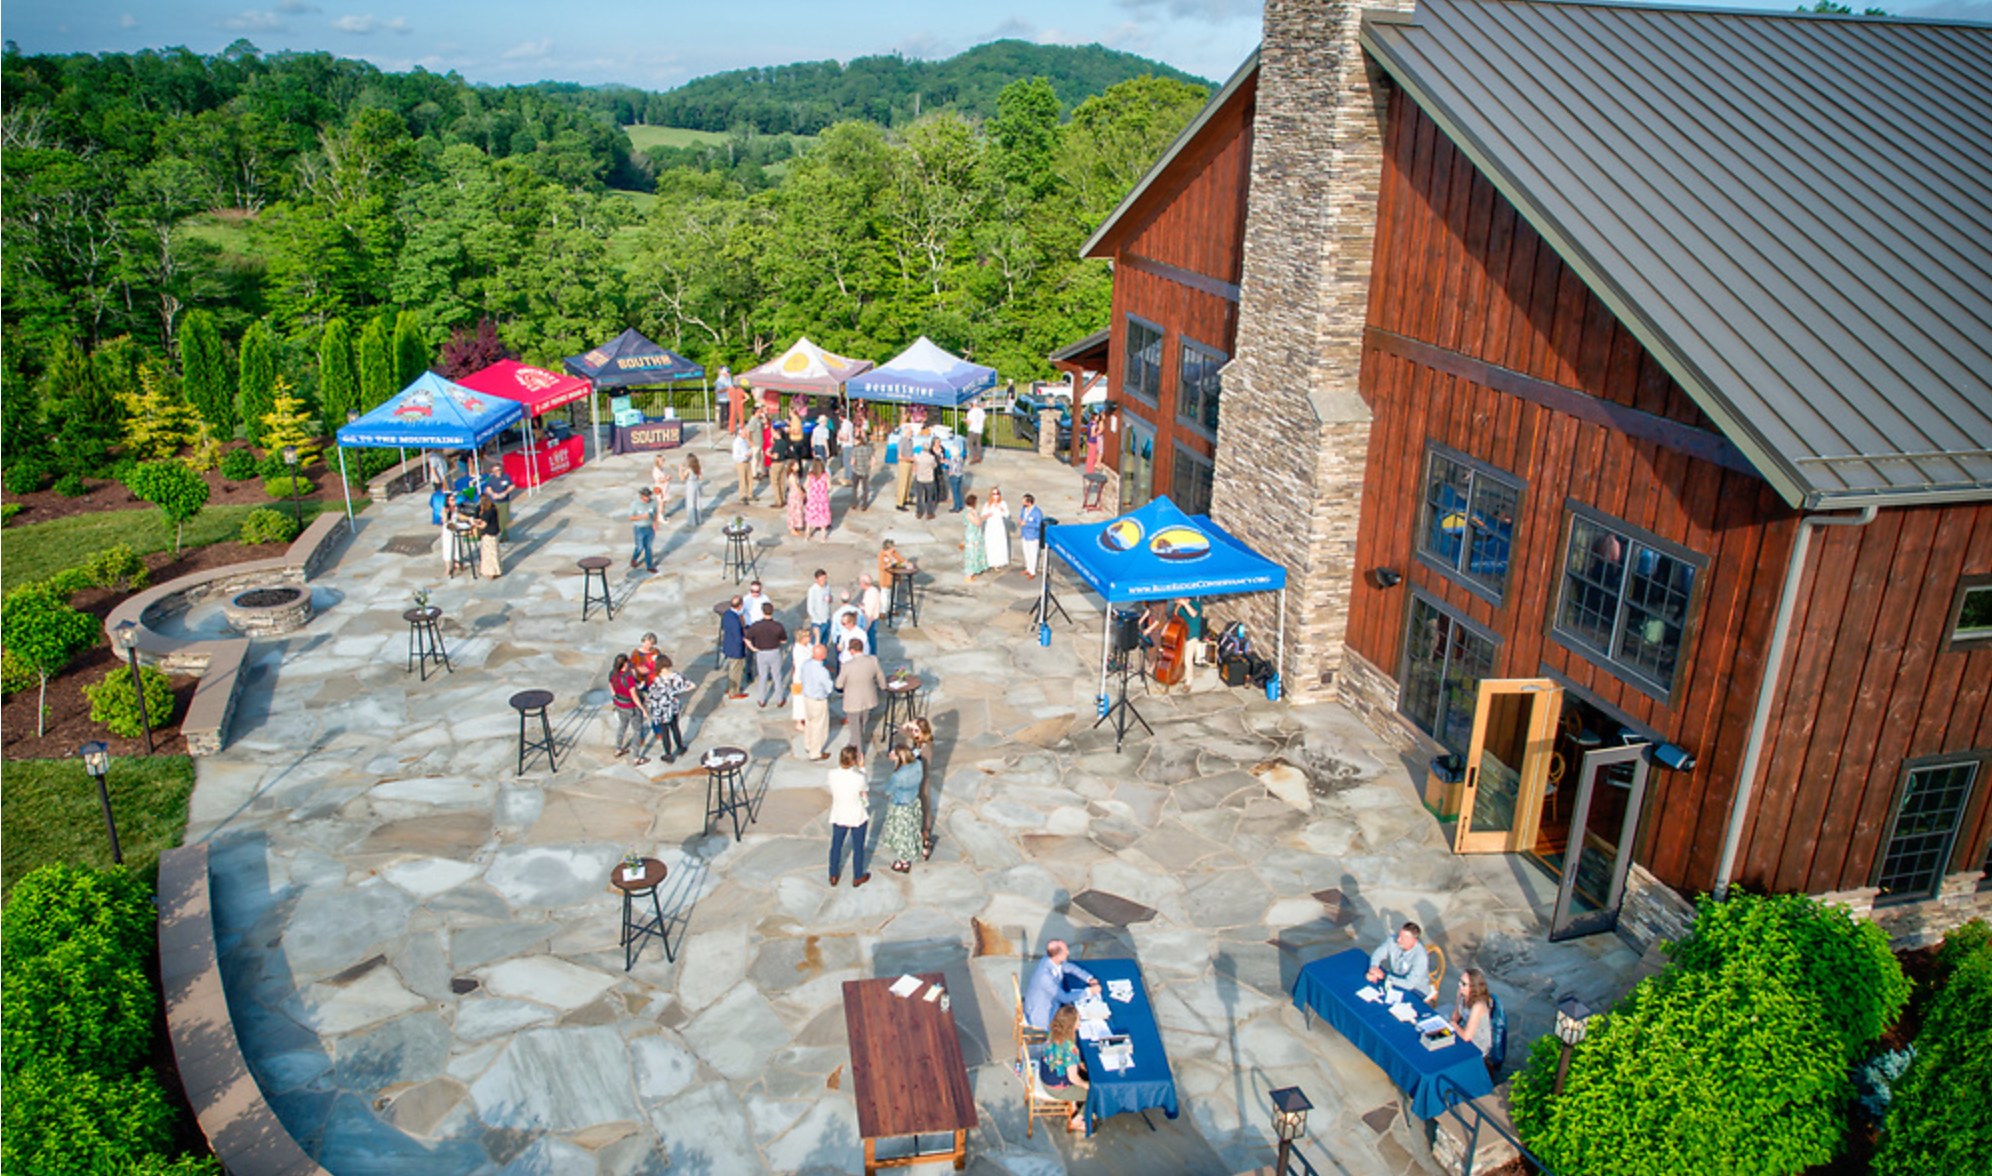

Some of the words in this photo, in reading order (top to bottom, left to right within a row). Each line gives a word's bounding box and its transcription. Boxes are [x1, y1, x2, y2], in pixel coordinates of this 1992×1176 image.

[617, 356, 661, 369] SOUTH
[342, 435, 357, 443] GO
[358, 435, 373, 443] TO
[631, 429, 669, 443] SOUTH
